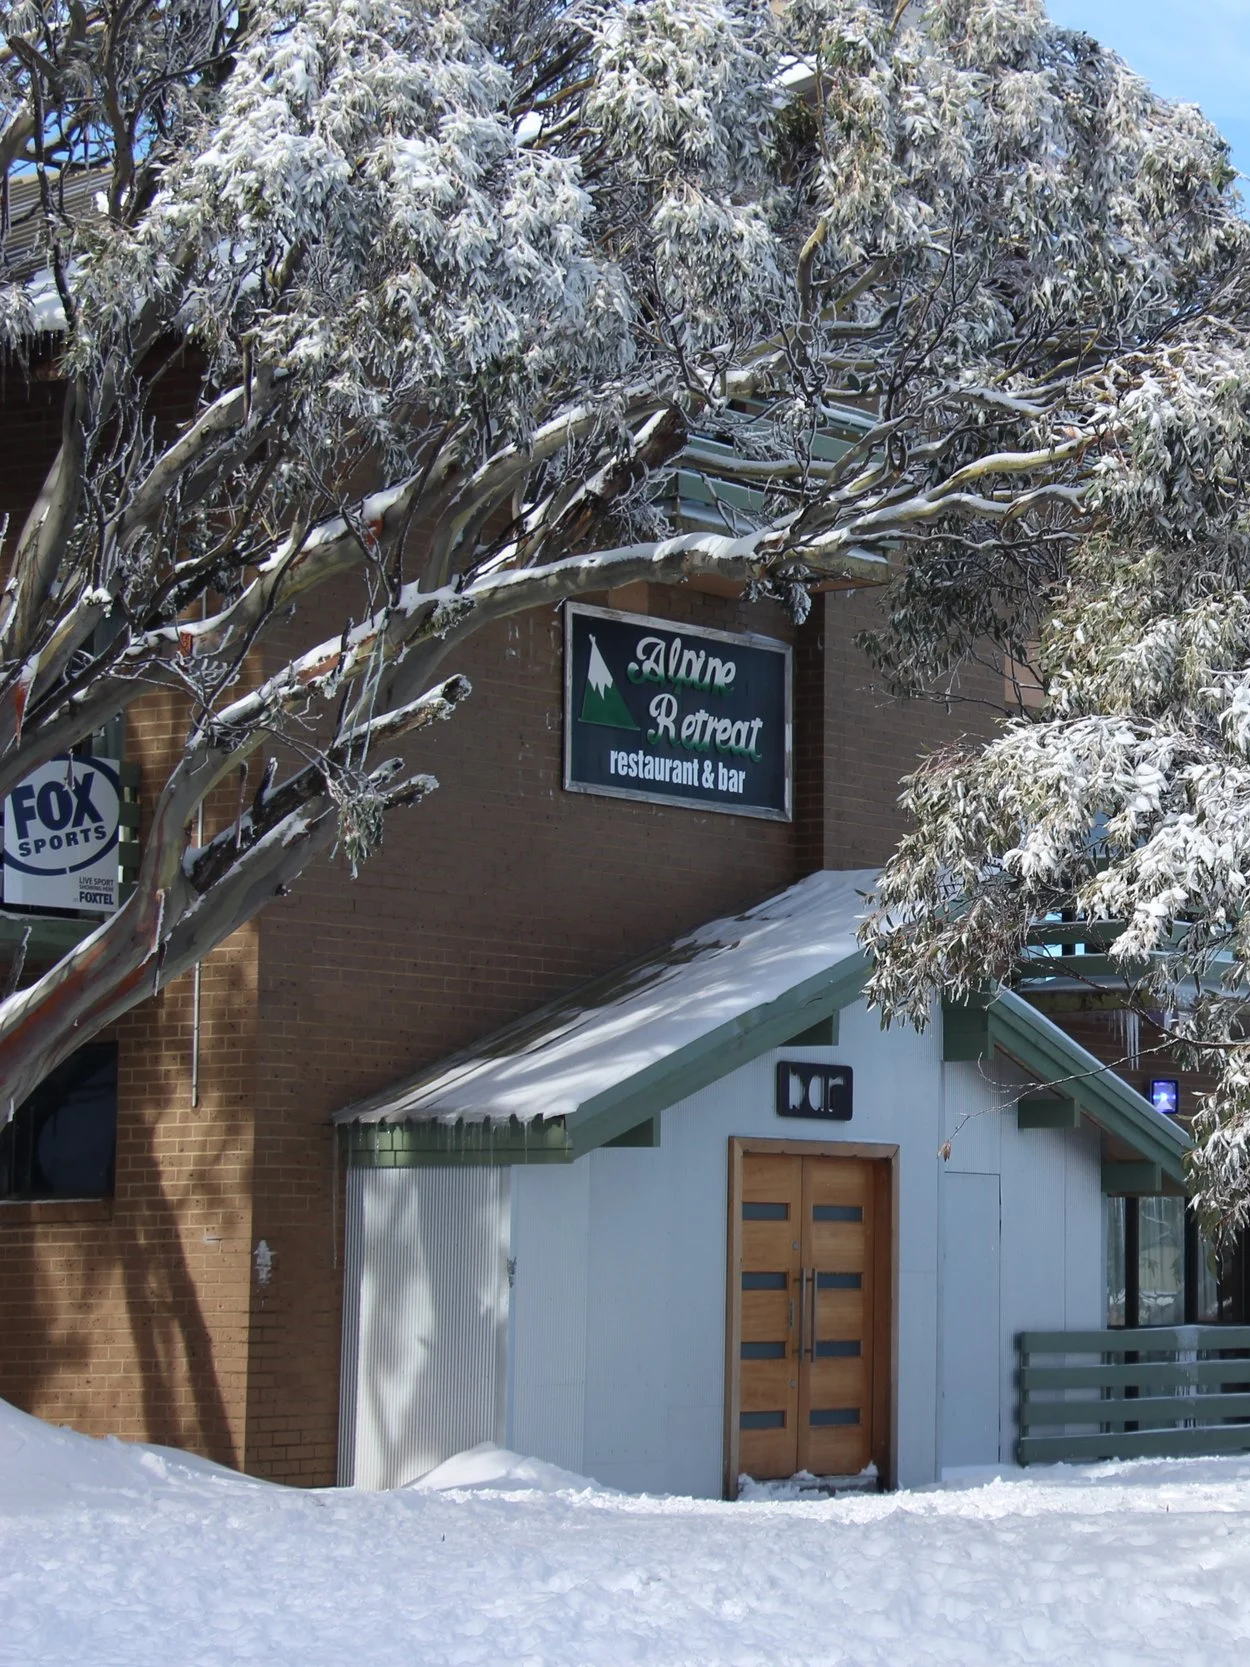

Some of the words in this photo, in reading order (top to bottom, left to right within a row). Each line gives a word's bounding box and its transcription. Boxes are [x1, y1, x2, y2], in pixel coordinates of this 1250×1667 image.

[627, 637, 736, 695] Alpine
[647, 693, 763, 763] Retreat
[610, 750, 699, 787] restaurant
[702, 760, 715, 789] &
[718, 763, 746, 793] bar
[11, 771, 104, 840] FOX
[18, 825, 107, 857] SPORTS
[79, 876, 92, 885] LIVE
[93, 877, 114, 887] SPORT
[79, 891, 114, 905] FOXTEL
